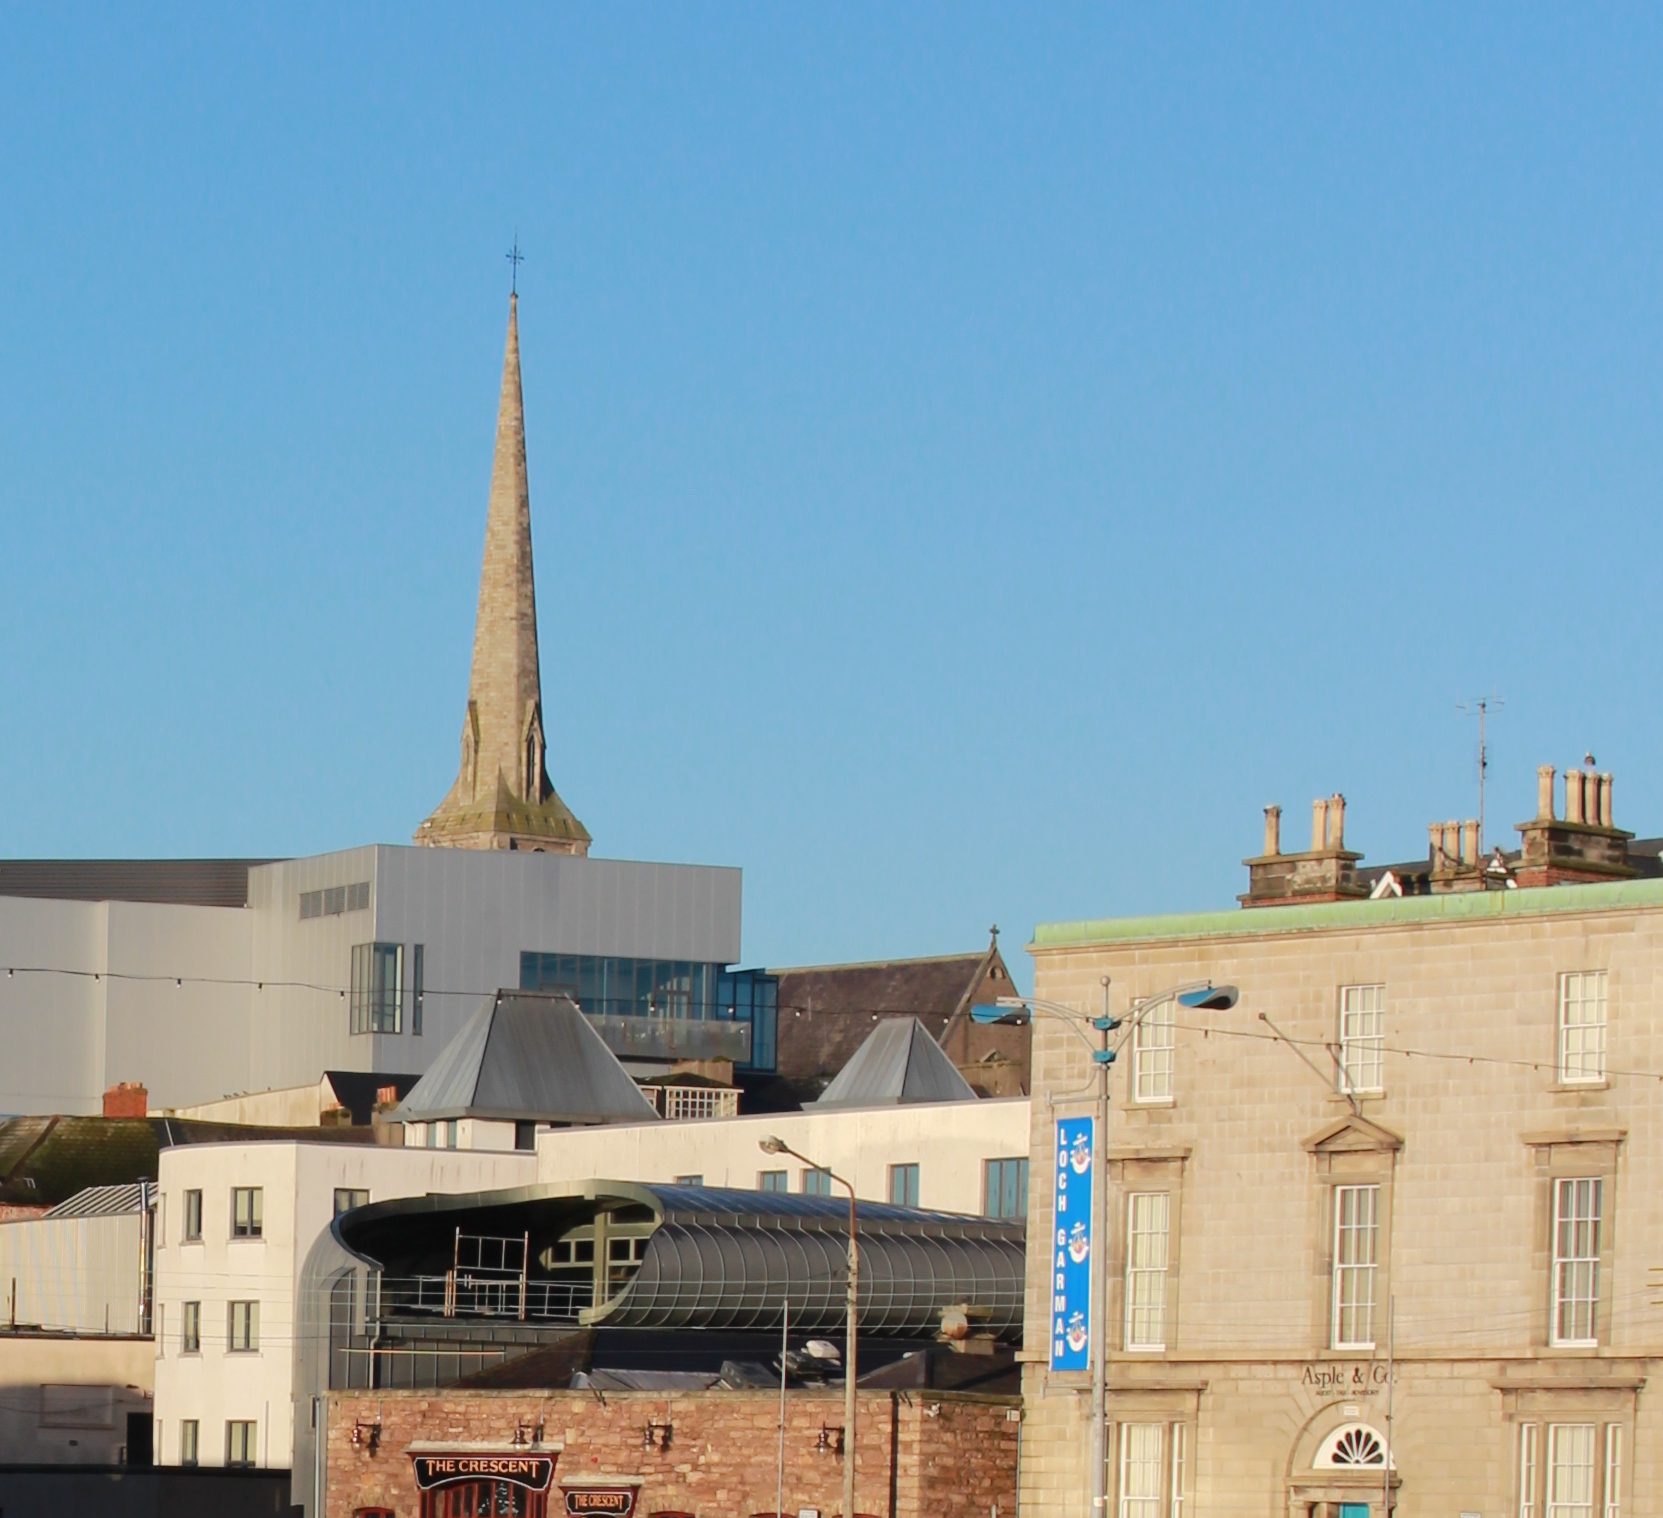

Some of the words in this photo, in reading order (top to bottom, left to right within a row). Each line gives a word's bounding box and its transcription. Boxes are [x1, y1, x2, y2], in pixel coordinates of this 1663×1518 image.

[1057, 1128, 1067, 1212] LOCH
[1054, 1228, 1066, 1357] GARMAN
[1302, 1366, 1344, 1388] Asple
[1352, 1367, 1364, 1384] &
[1373, 1366, 1398, 1385] Co.
[426, 1460, 455, 1476] THE
[458, 1460, 540, 1478] CRESCENT
[574, 1494, 588, 1509] THE
[589, 1494, 624, 1510] CRESCENT
